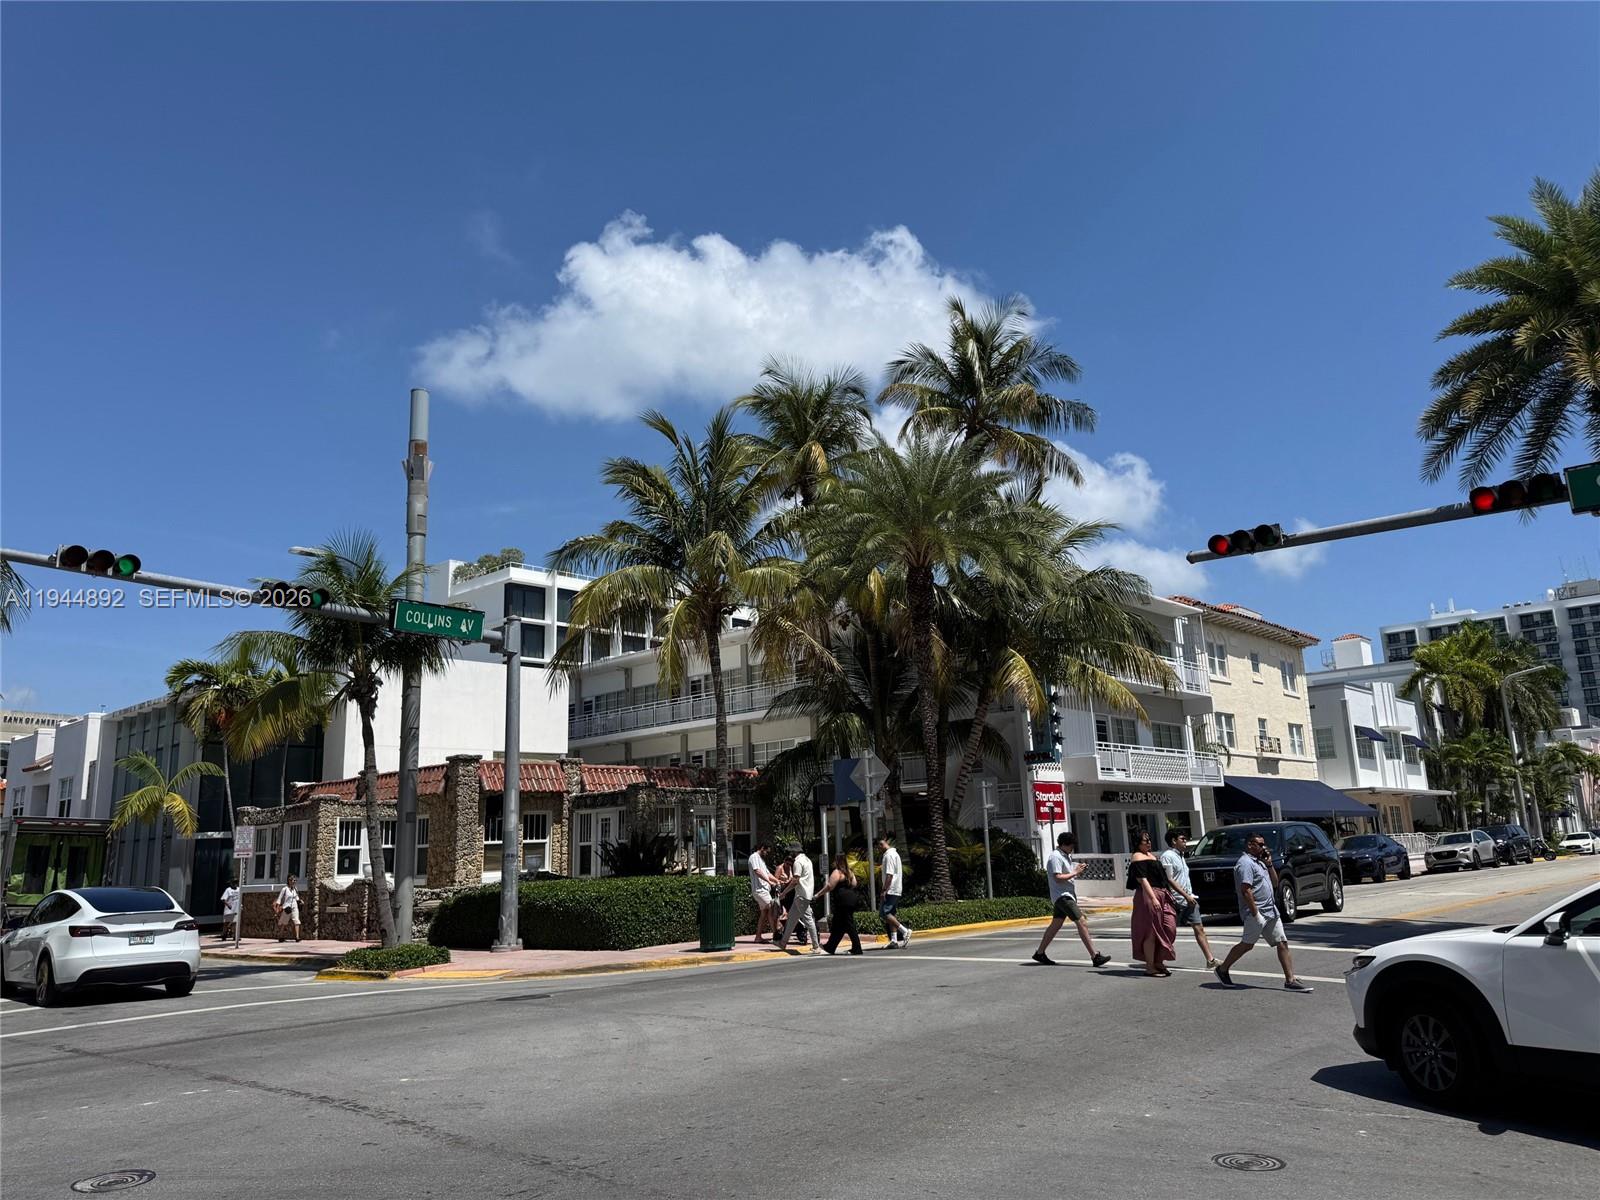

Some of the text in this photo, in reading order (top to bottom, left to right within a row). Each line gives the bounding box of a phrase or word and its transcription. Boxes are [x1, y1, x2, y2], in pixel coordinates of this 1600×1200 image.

[406, 610, 474, 632] COLLINS AV
[3, 715, 24, 724] BANK
[25, 717, 34, 725] OF
[1035, 791, 1063, 802] Stardust
[1119, 791, 1147, 804] ESCAPE
[1147, 792, 1172, 805] ROOMS
